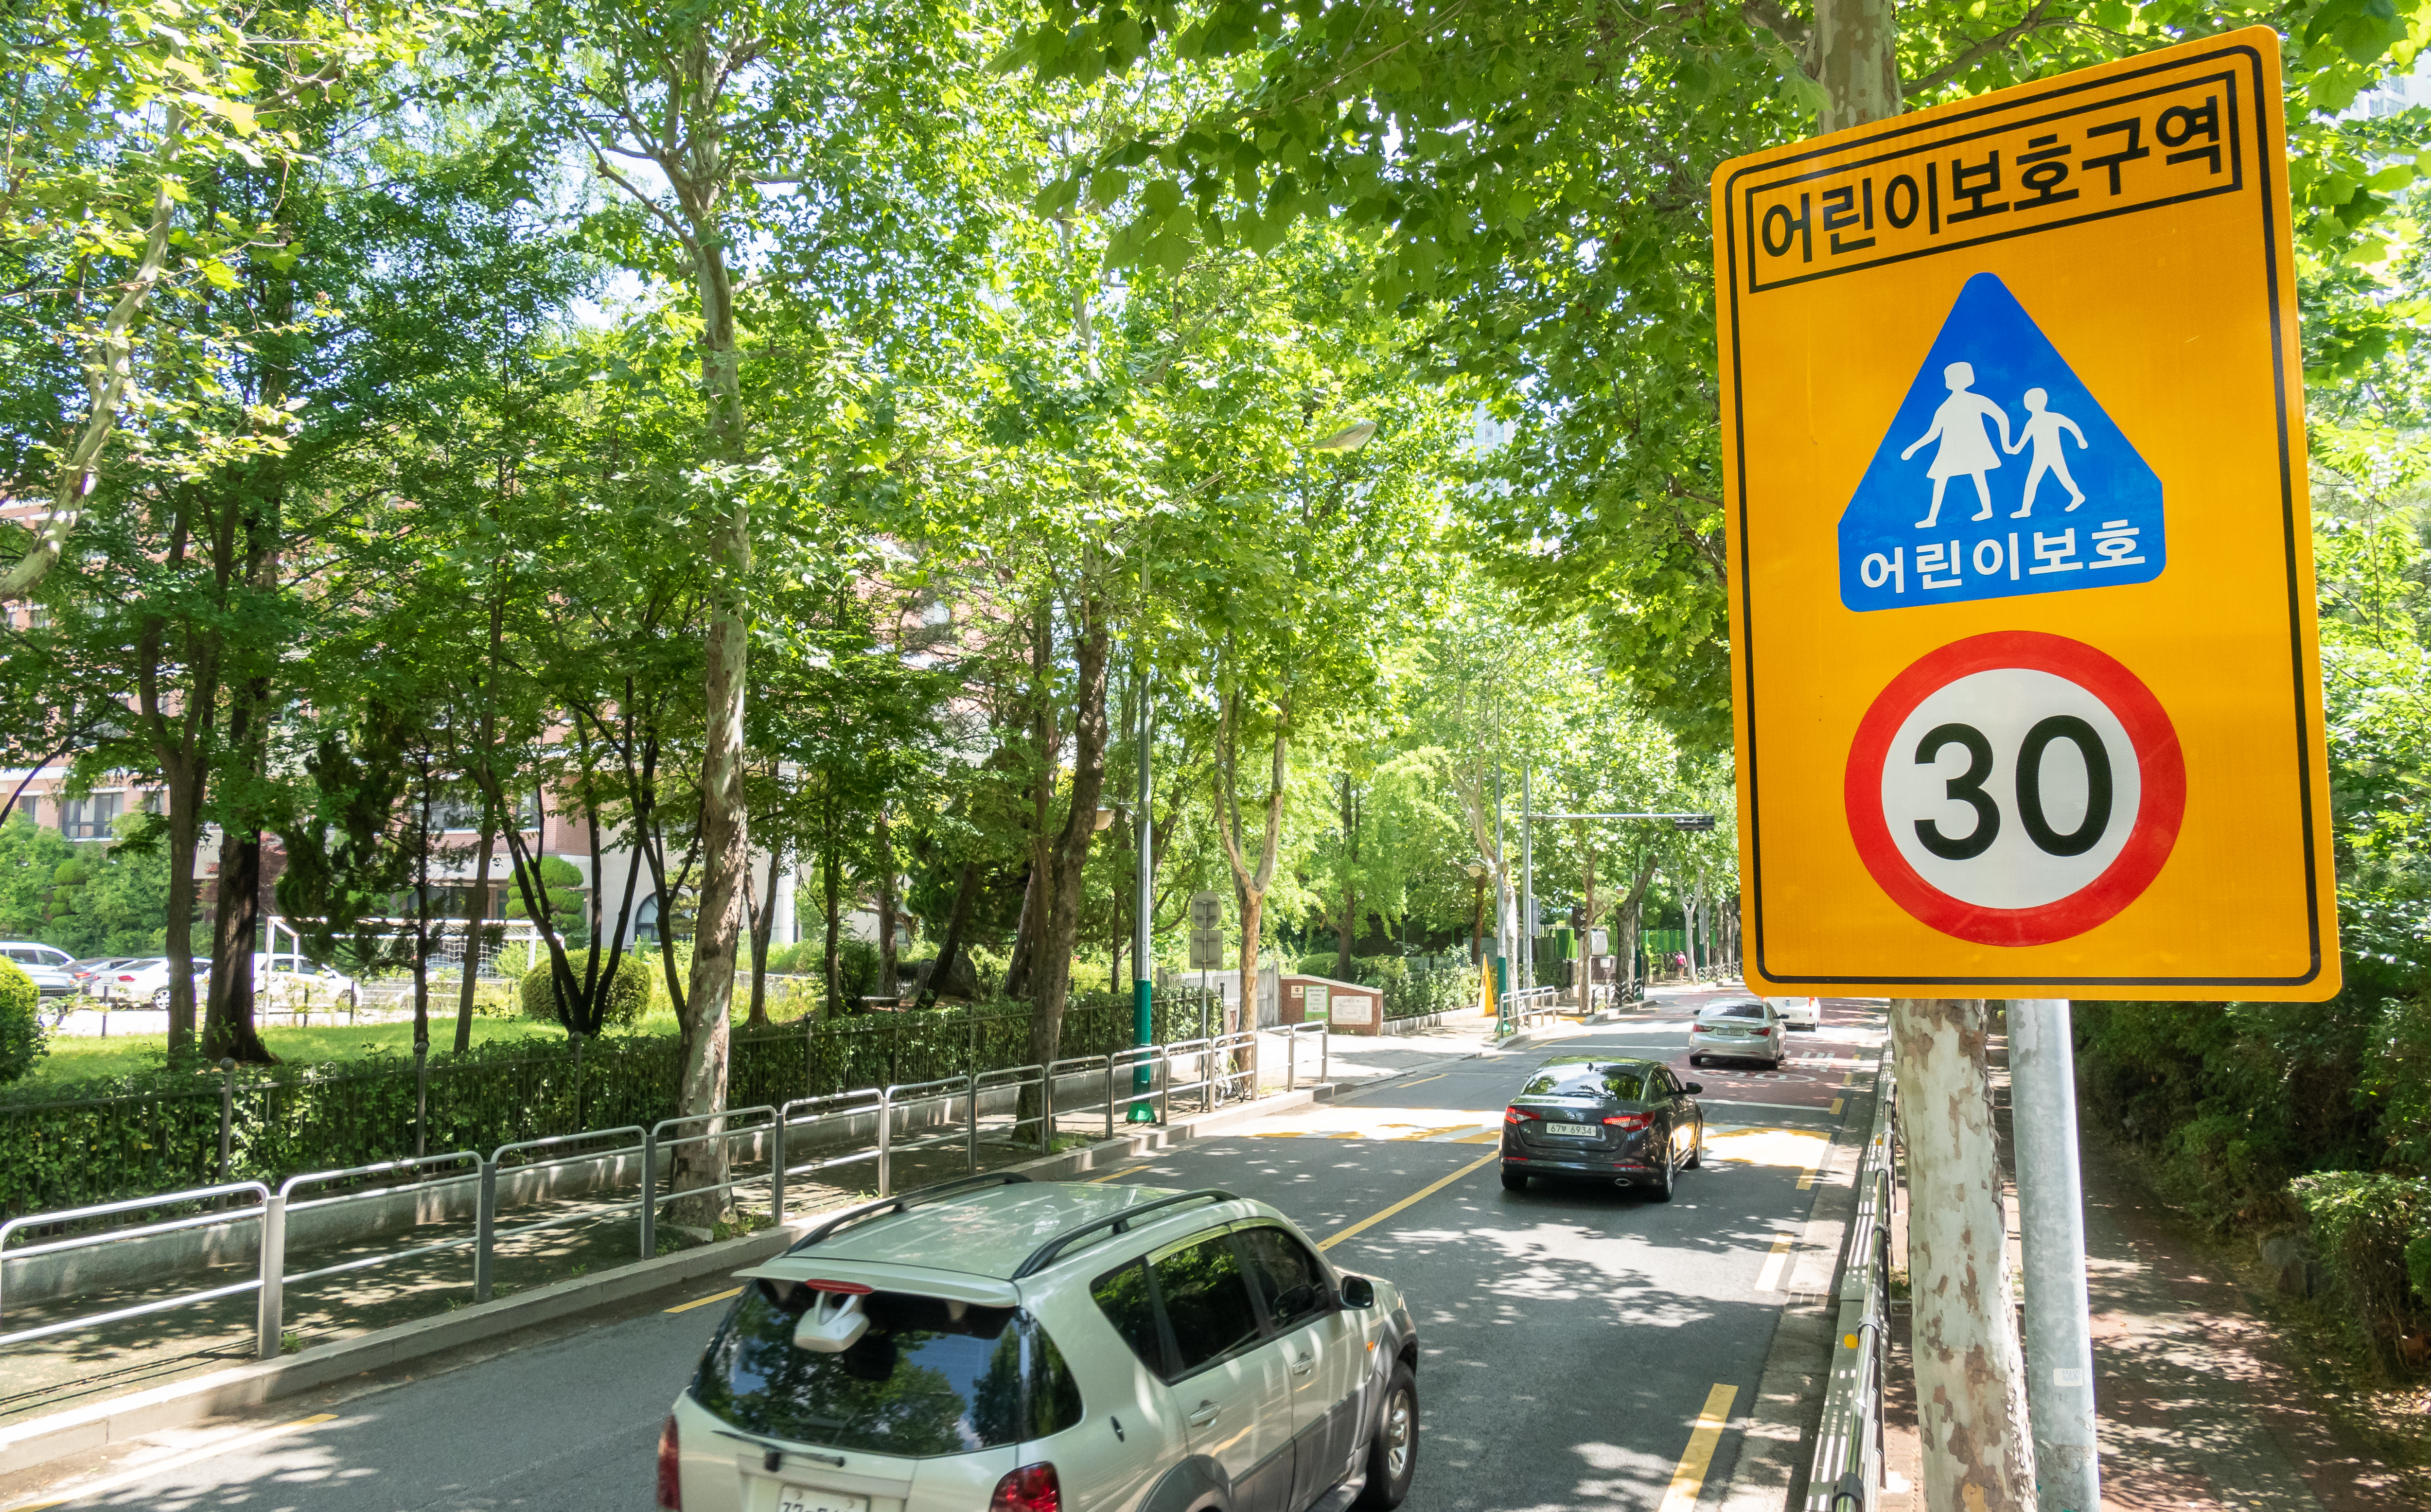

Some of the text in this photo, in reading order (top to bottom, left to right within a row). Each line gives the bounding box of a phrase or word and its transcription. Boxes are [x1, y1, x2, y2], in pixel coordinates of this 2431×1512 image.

[1762, 95, 2221, 263] 어린이보호구역
[1861, 520, 2146, 594] 어린이보호
[1914, 715, 2113, 861] 30
[1570, 1125, 1592, 1135] 6934
